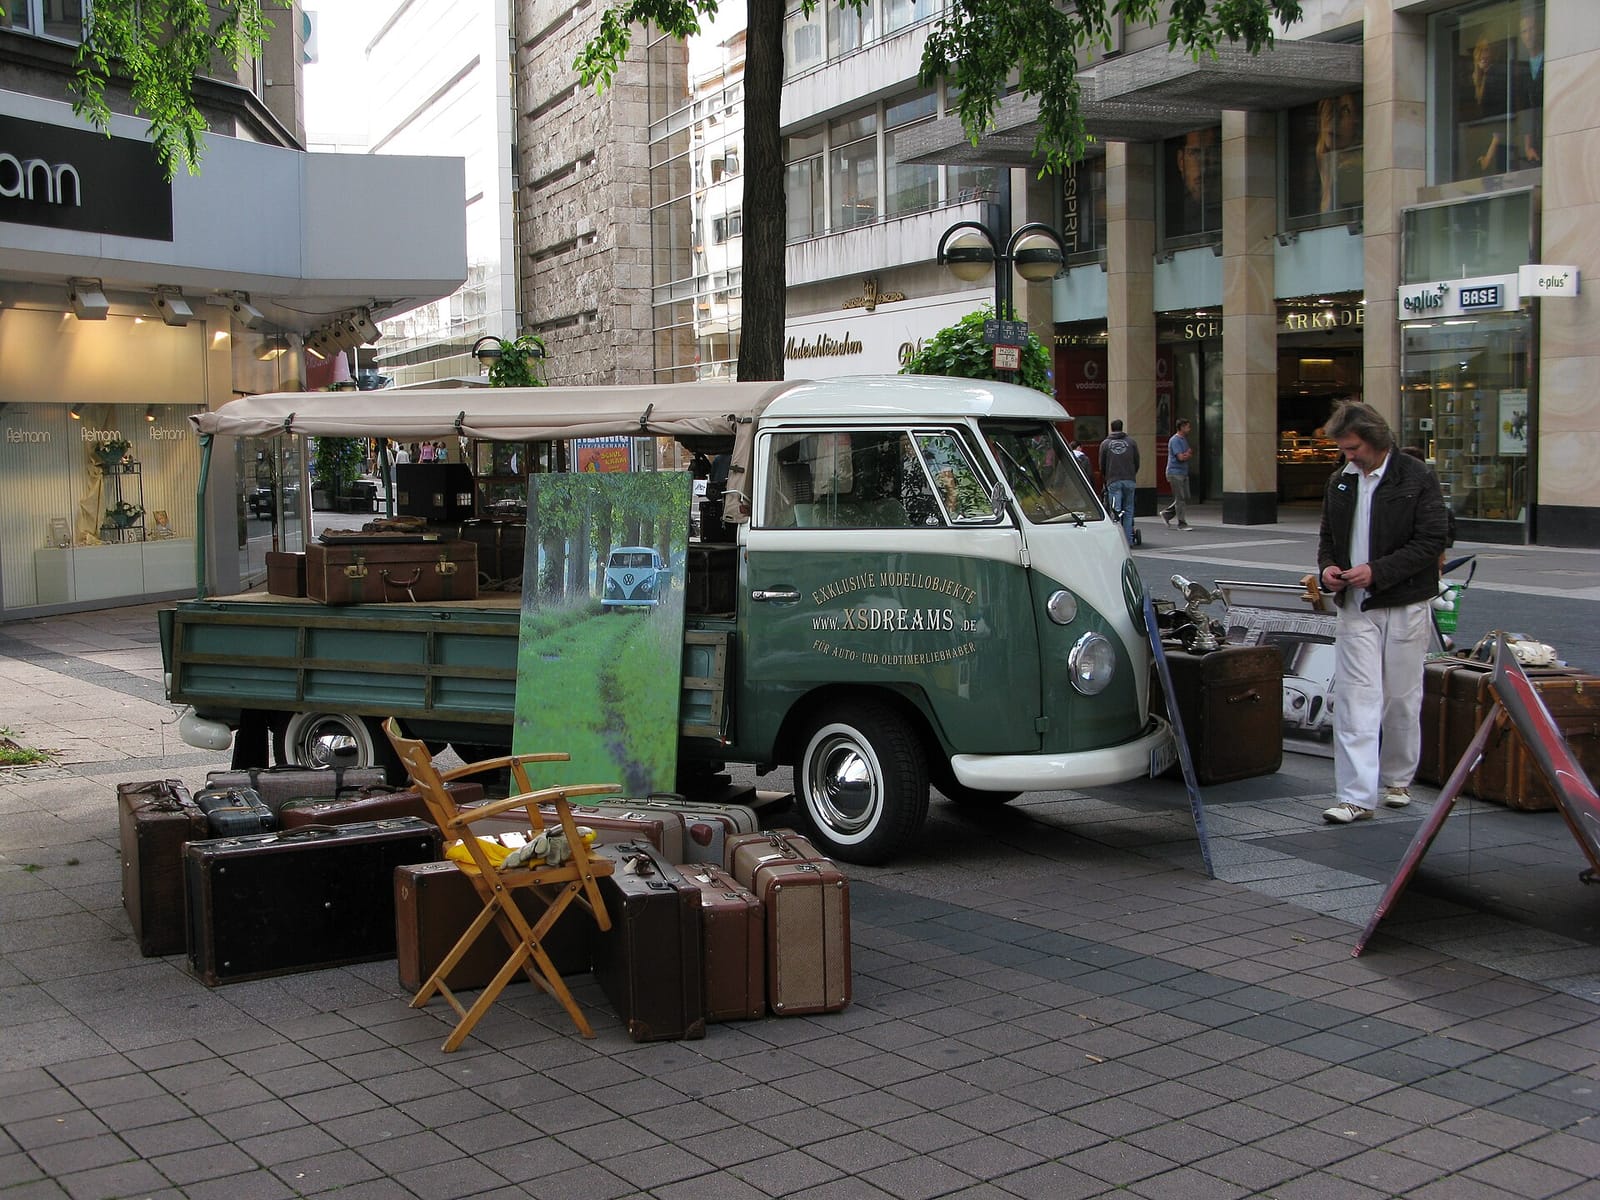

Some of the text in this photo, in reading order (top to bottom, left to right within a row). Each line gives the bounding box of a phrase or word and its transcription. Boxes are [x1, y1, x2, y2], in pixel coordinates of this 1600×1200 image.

[1462, 289, 1496, 305] BASE
[812, 571, 976, 605] EXKLUSIVE MODELLOBJEKTE
[812, 639, 976, 665] FÜR AUTO- UND OLDTIMERLIEBHABER
